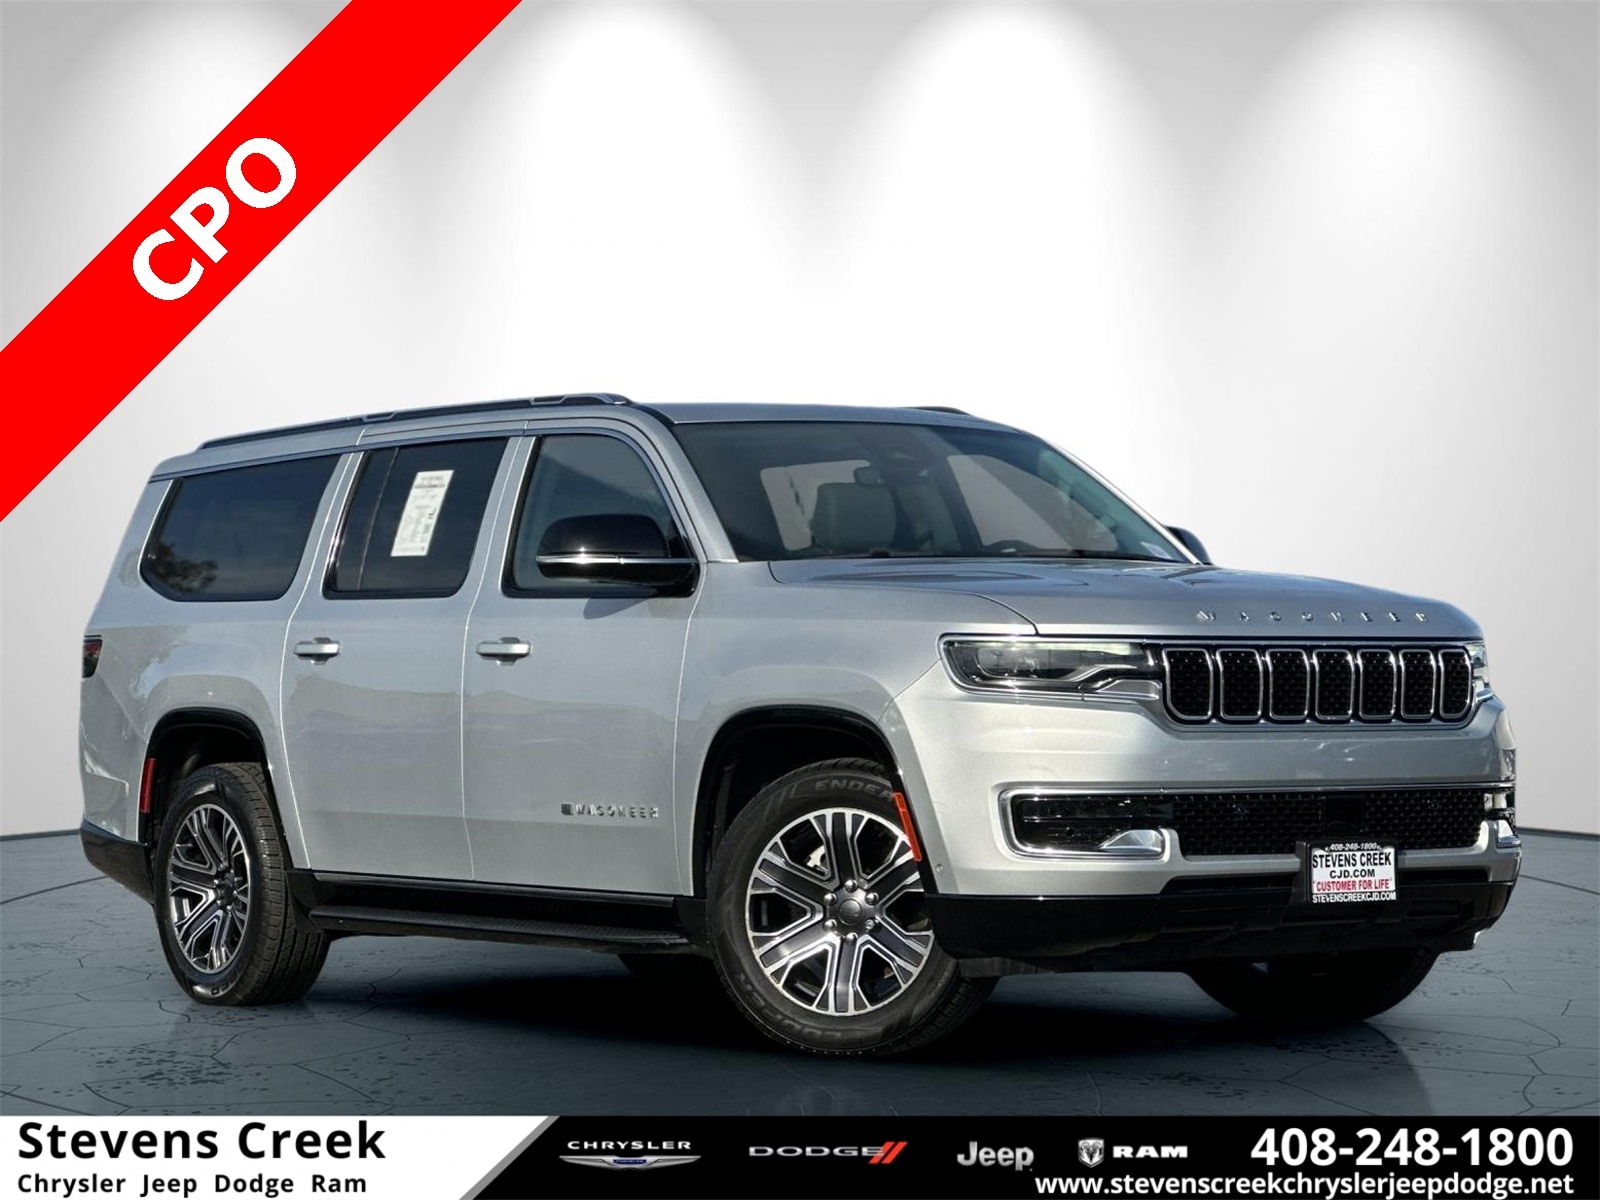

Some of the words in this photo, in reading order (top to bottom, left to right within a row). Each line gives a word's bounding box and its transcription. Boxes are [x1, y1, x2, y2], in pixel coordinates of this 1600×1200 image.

[1312, 854, 1357, 868] STEVENS
[1360, 852, 1391, 866] CREEK
[1329, 869, 1375, 878] CJD.COM
[1358, 880, 1373, 890] FOR
[1312, 891, 1396, 903] STEVENSCREEKCJD.COM
